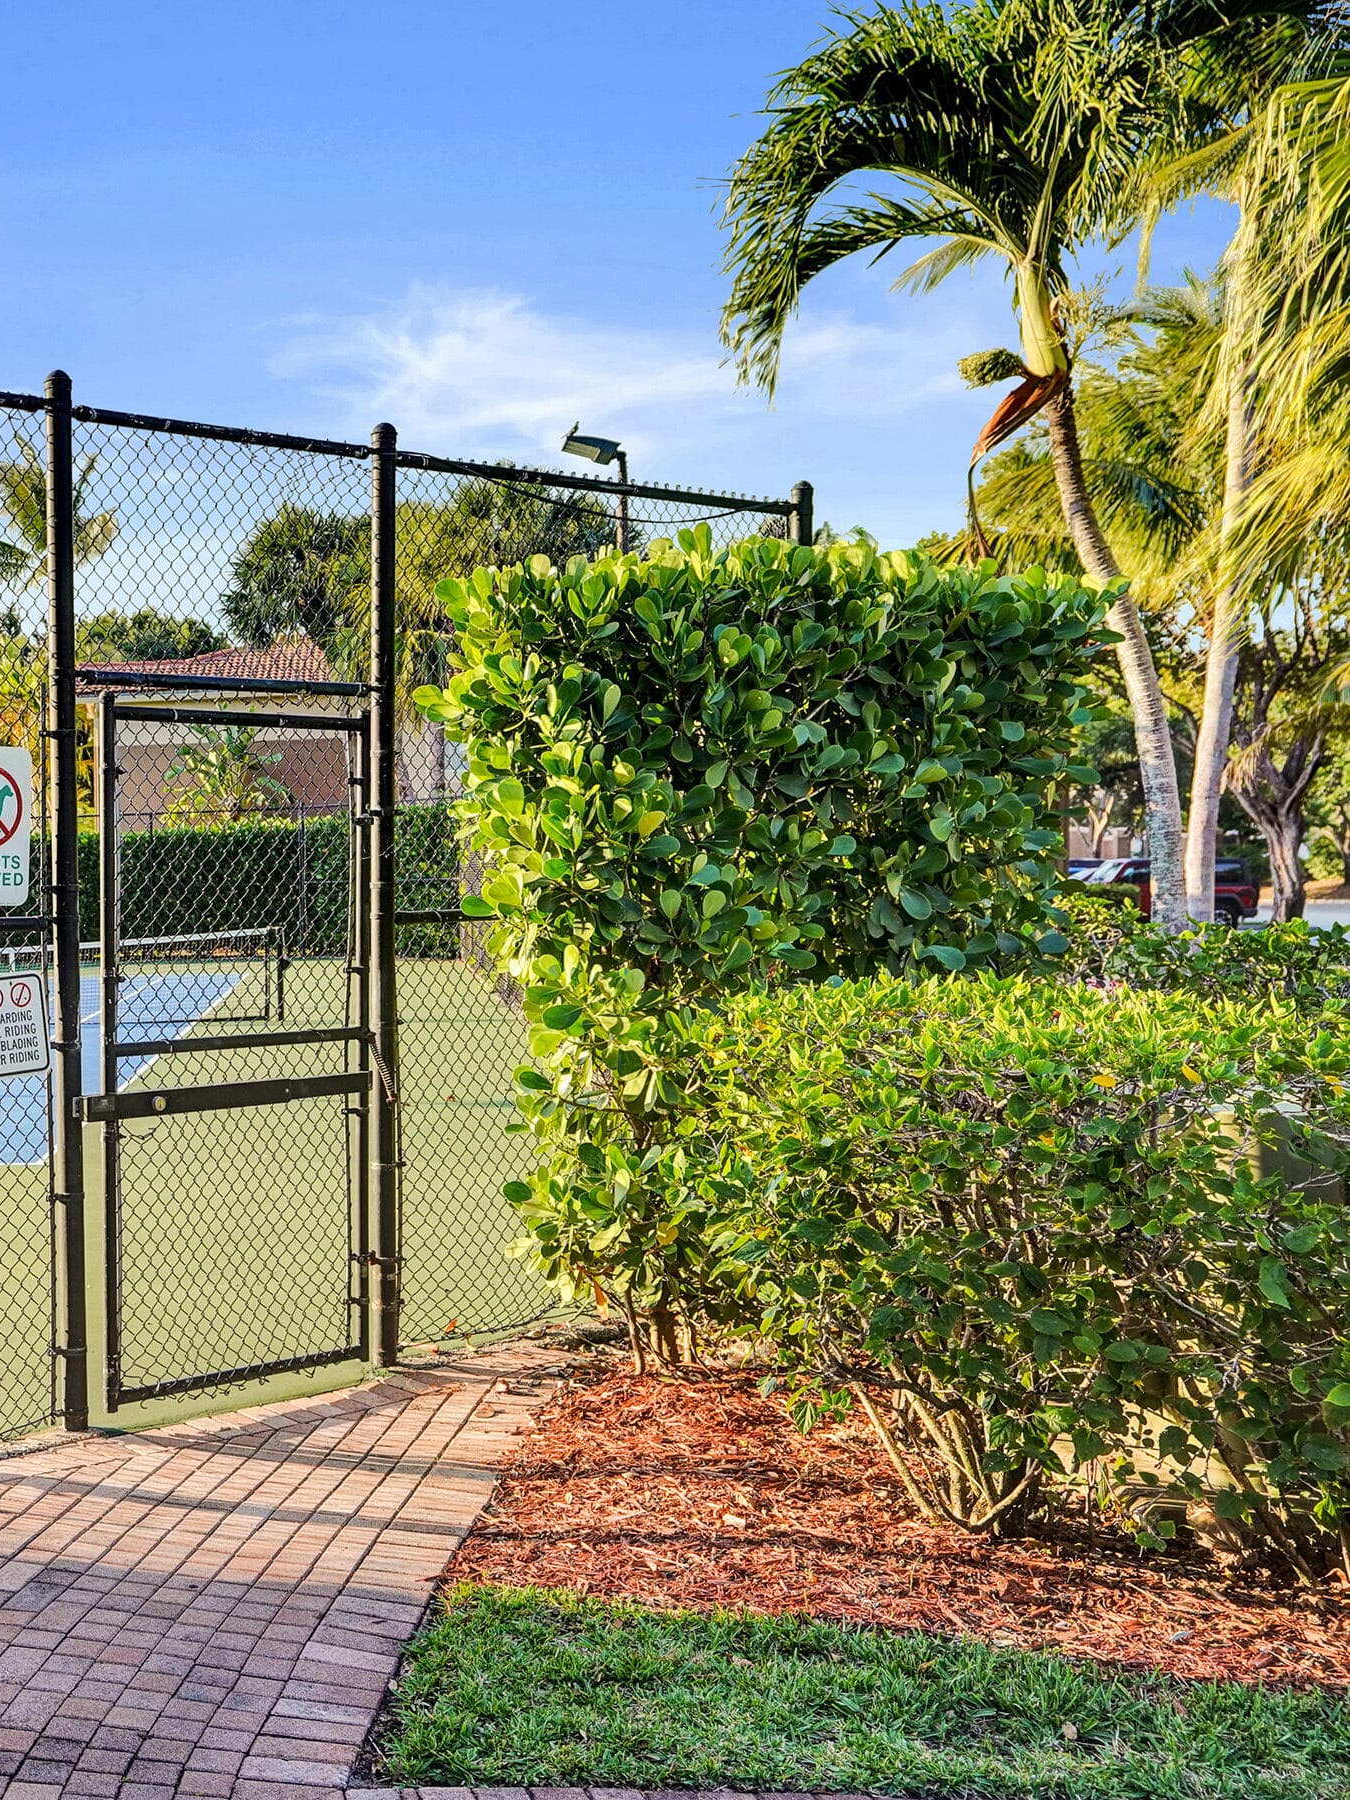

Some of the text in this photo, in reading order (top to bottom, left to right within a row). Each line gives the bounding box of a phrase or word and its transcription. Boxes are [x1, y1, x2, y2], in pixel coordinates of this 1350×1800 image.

[5, 1023, 37, 1038] RIDING
[1, 1036, 39, 1052] BLADING
[9, 1050, 40, 1065] RIDING
